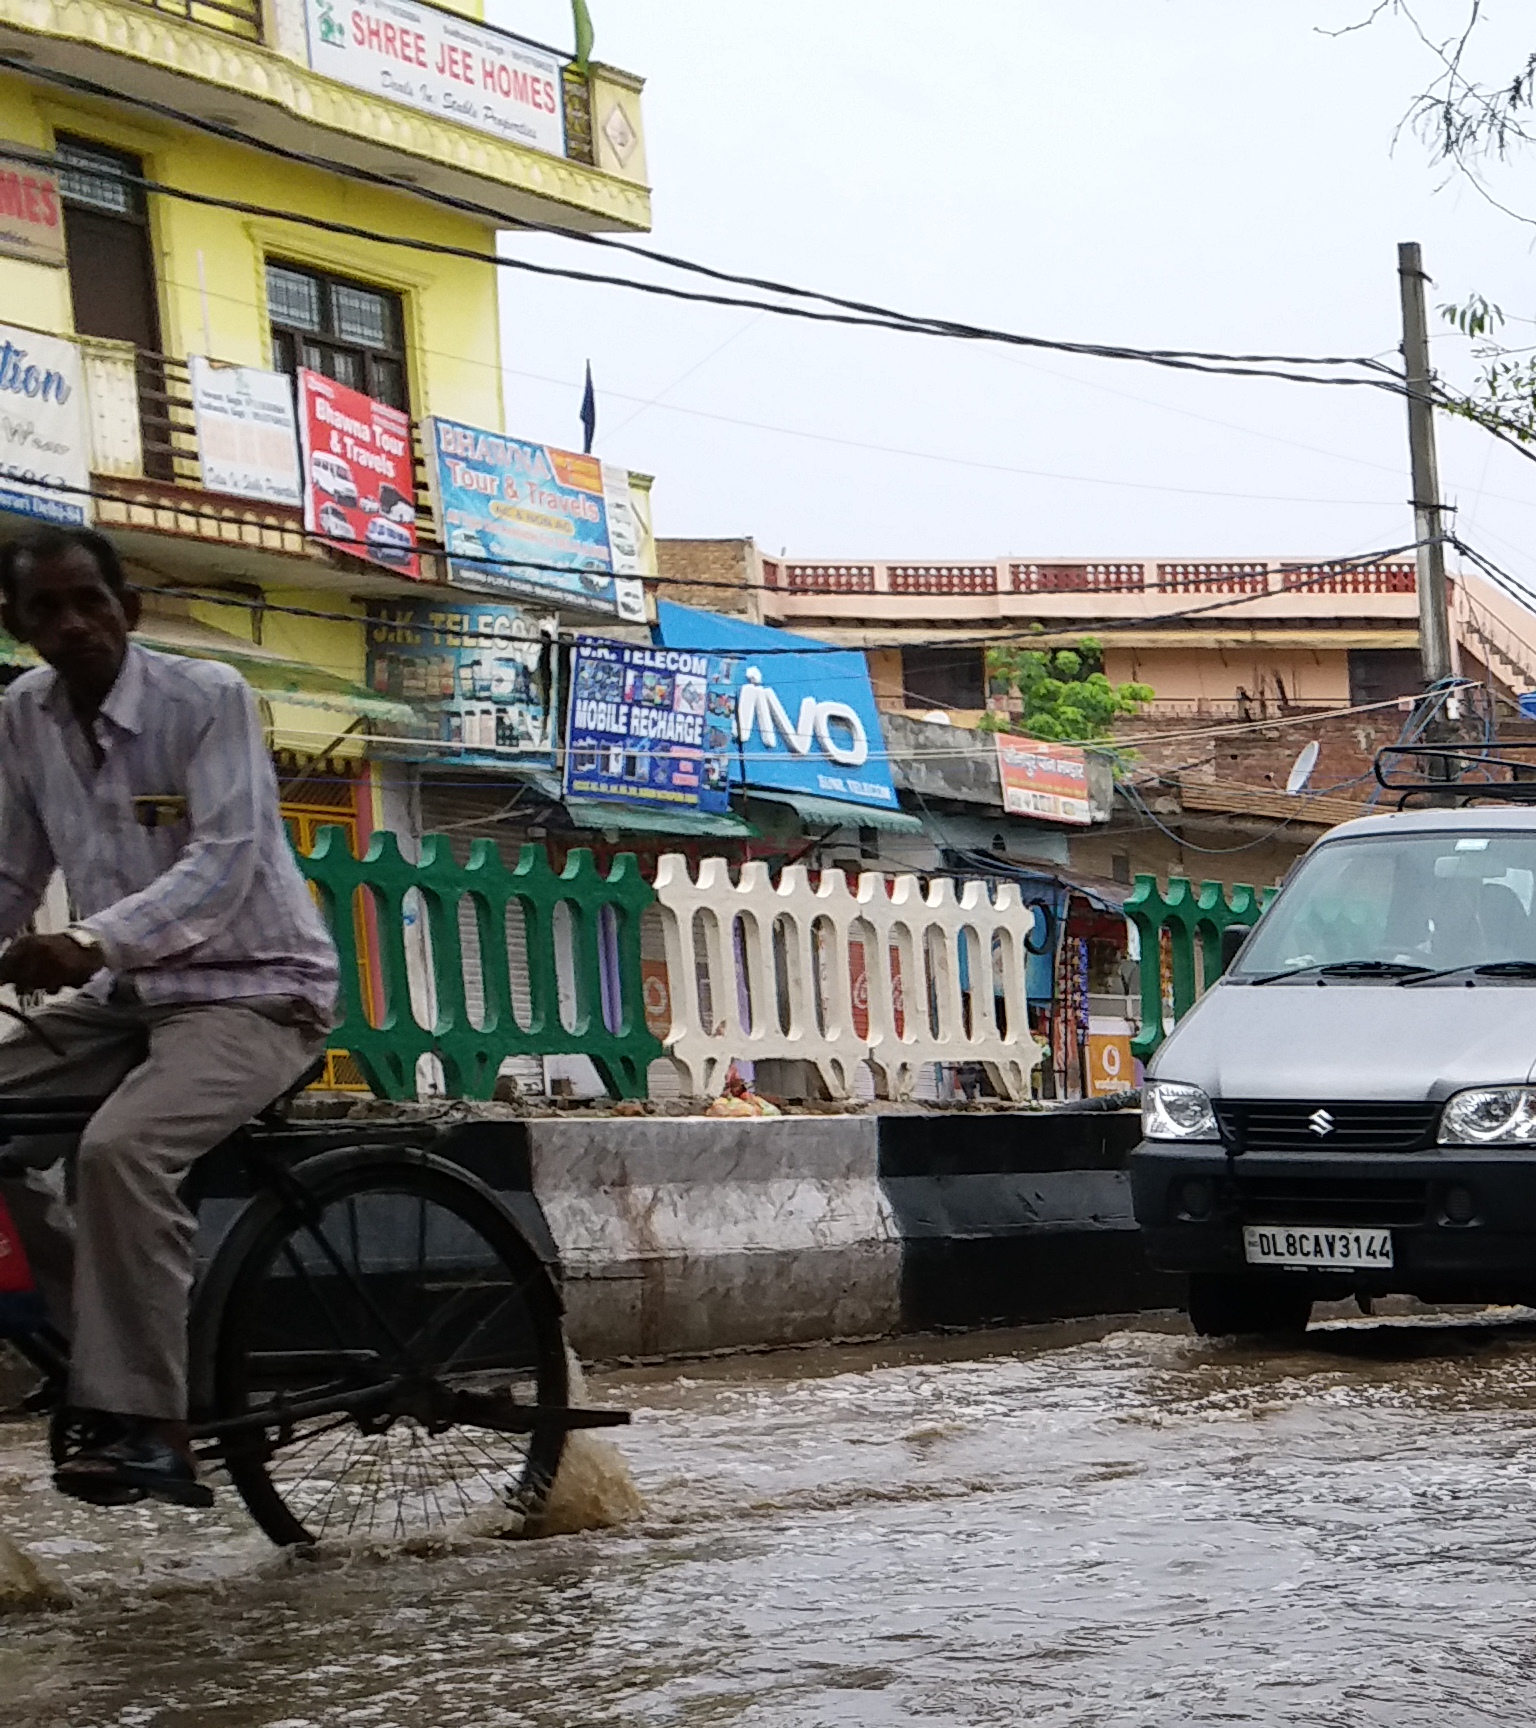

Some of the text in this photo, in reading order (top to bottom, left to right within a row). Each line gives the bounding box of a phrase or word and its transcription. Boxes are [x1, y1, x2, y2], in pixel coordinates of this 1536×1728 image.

[351, 10, 428, 69] SHREE
[435, 42, 475, 86] JEE
[482, 58, 556, 114] HOMES
[315, 396, 371, 443] Bhawna
[372, 424, 405, 457] Tour
[330, 429, 396, 478] & Travels
[437, 422, 552, 481] BHAWNA
[446, 458, 600, 523] Tour & Travels
[373, 609, 422, 645] J.K.
[624, 648, 708, 677] TELECOM
[574, 699, 704, 746] MOBILE RECHARGE
[1258, 1233, 1390, 1260] DL8CAV3144
